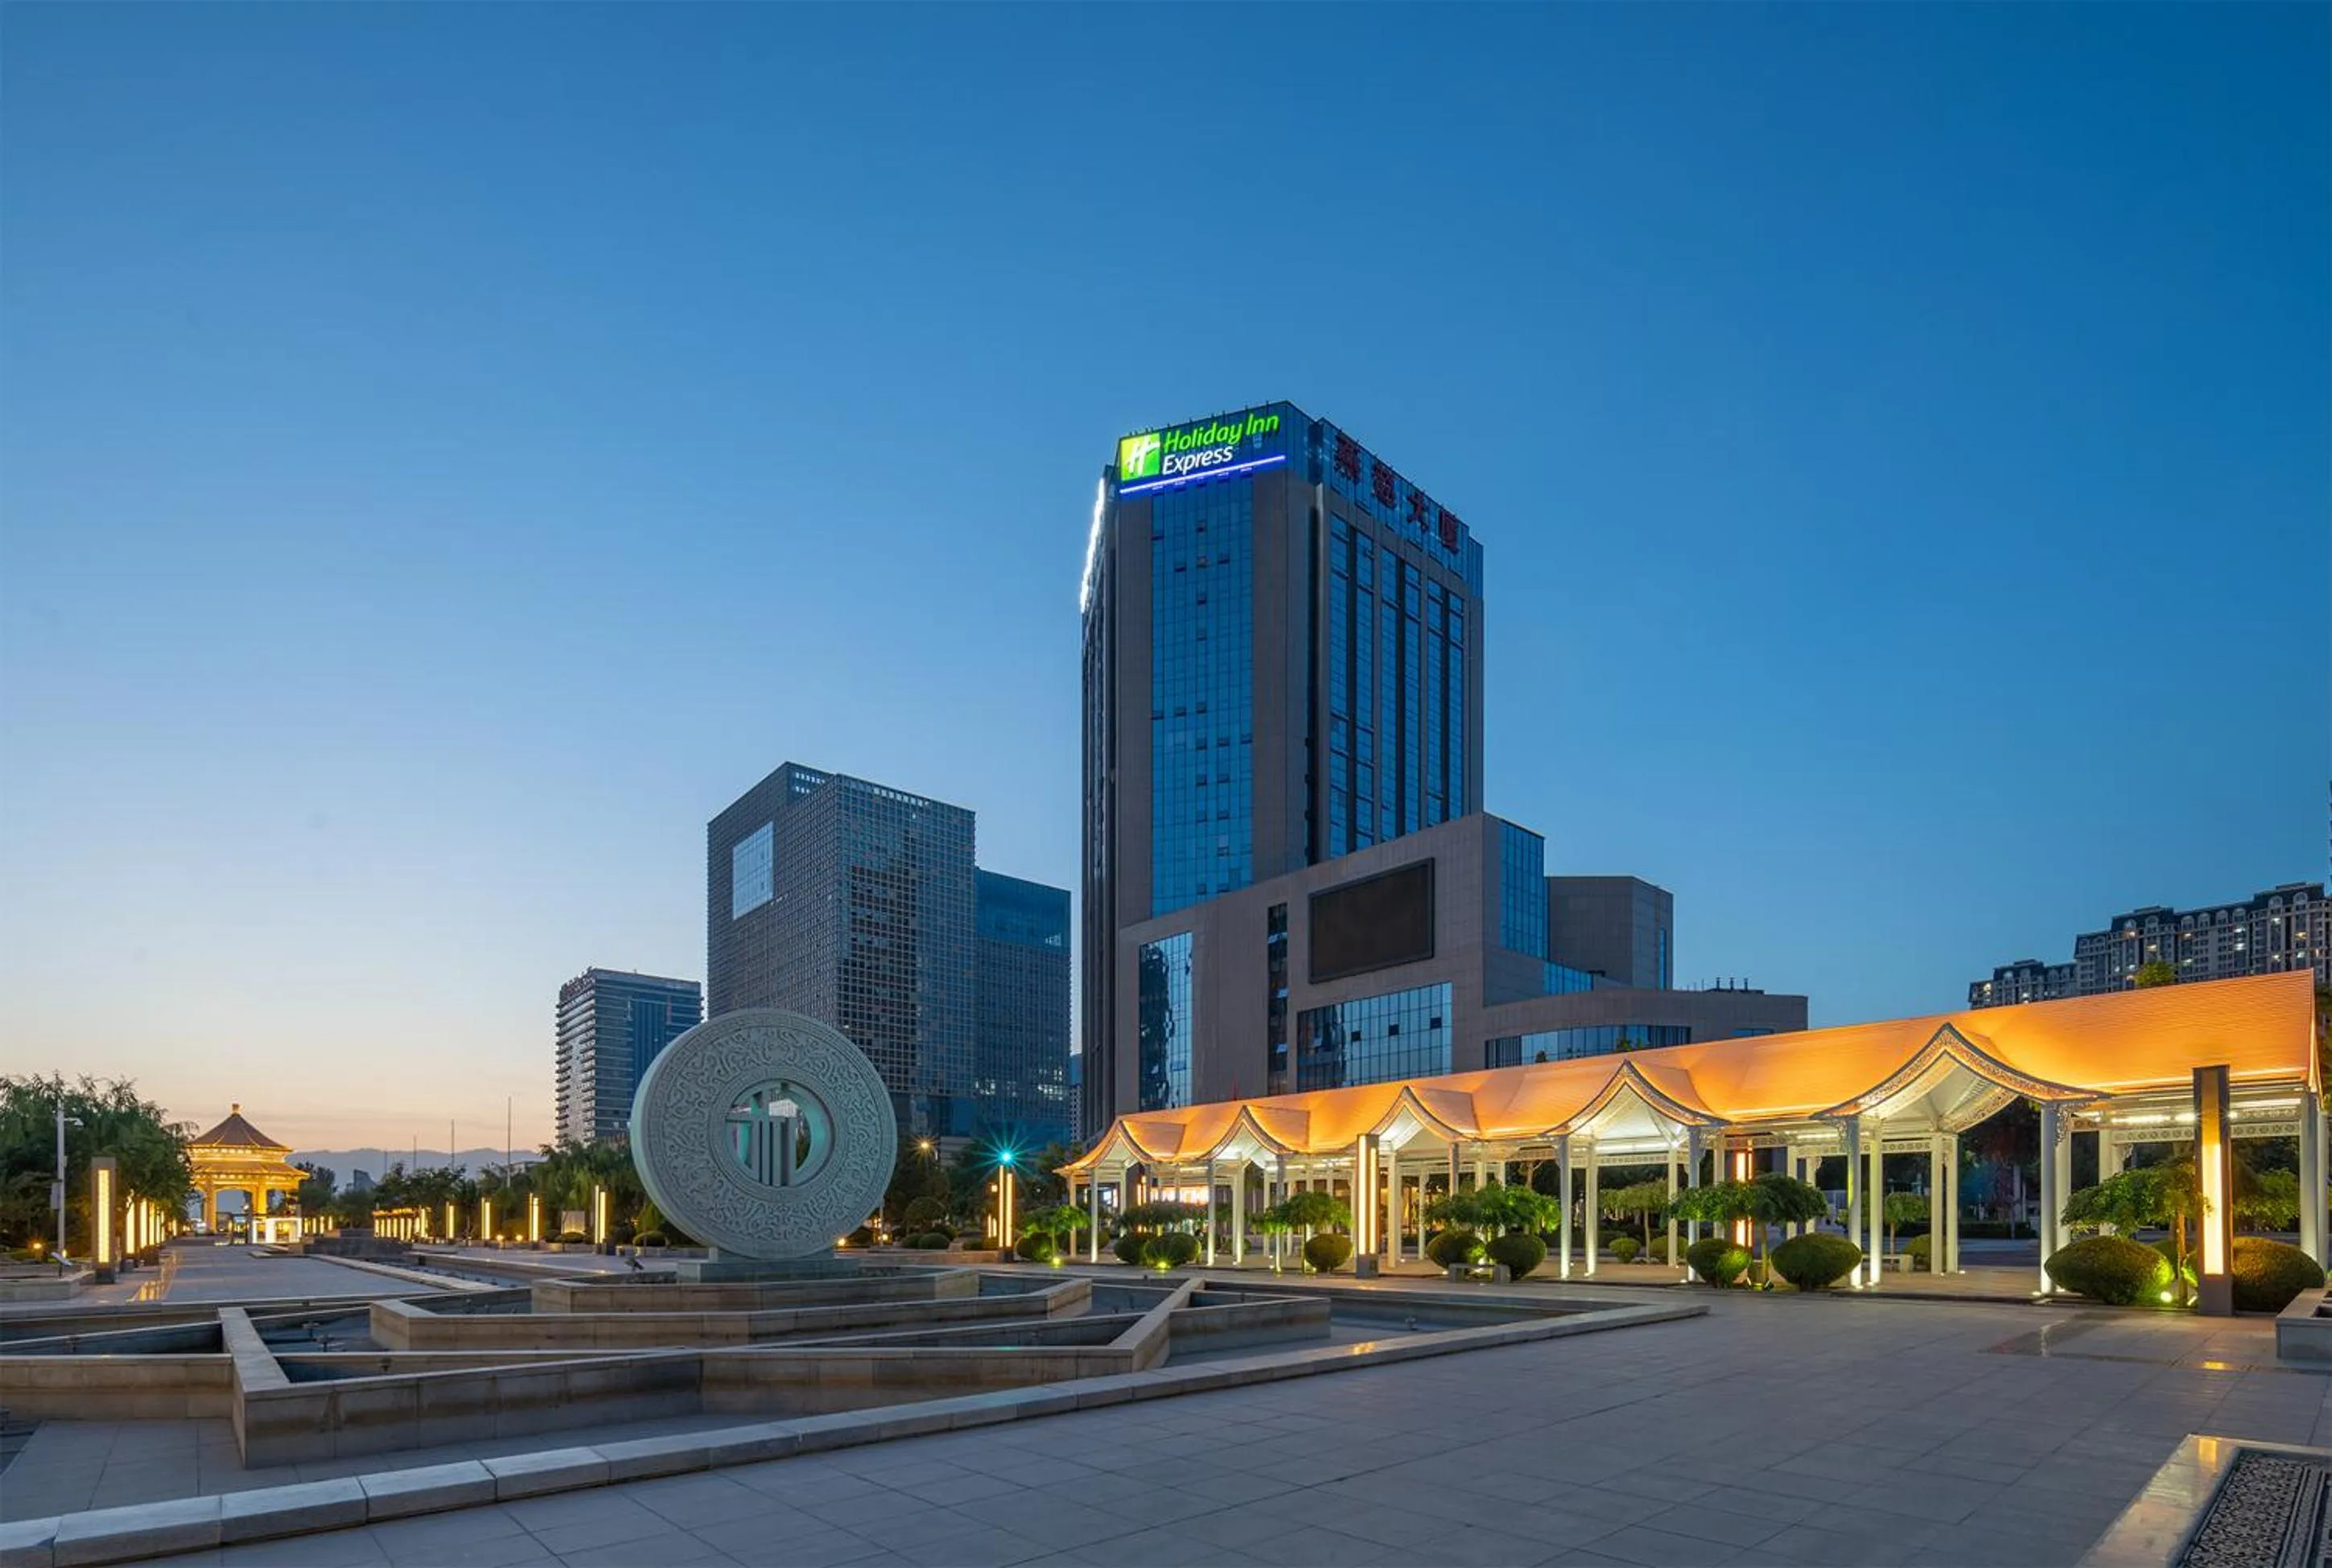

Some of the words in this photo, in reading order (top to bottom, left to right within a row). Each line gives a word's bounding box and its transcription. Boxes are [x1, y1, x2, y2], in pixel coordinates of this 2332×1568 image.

[1162, 421, 1242, 454] Holiday
[1246, 412, 1279, 436] Inn
[1162, 446, 1234, 475] Express
